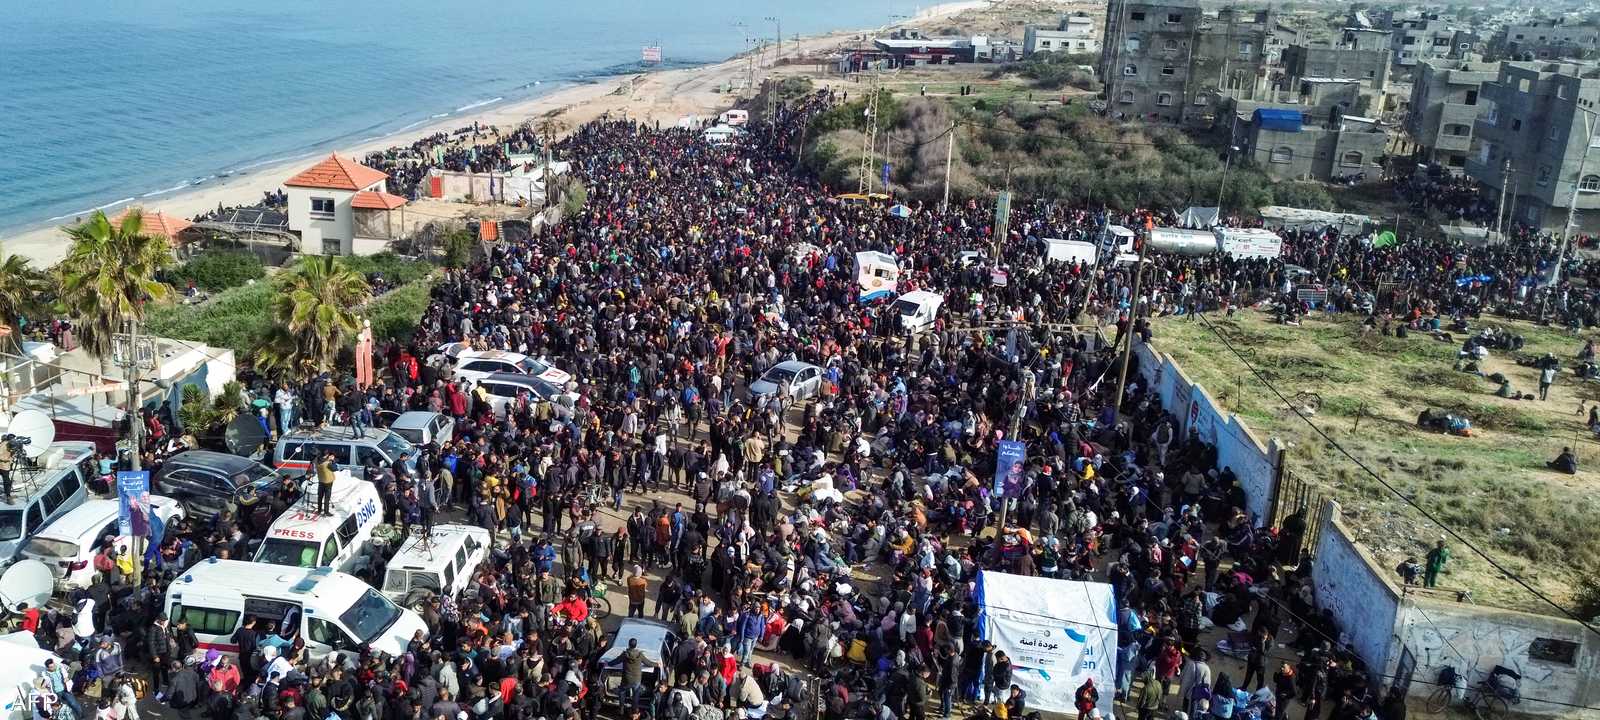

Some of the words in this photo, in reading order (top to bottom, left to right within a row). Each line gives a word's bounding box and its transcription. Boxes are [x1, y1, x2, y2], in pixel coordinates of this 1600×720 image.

[356, 498, 377, 528] DSNG
[274, 528, 315, 539] PRESS
[1038, 640, 1059, 650] عودة
